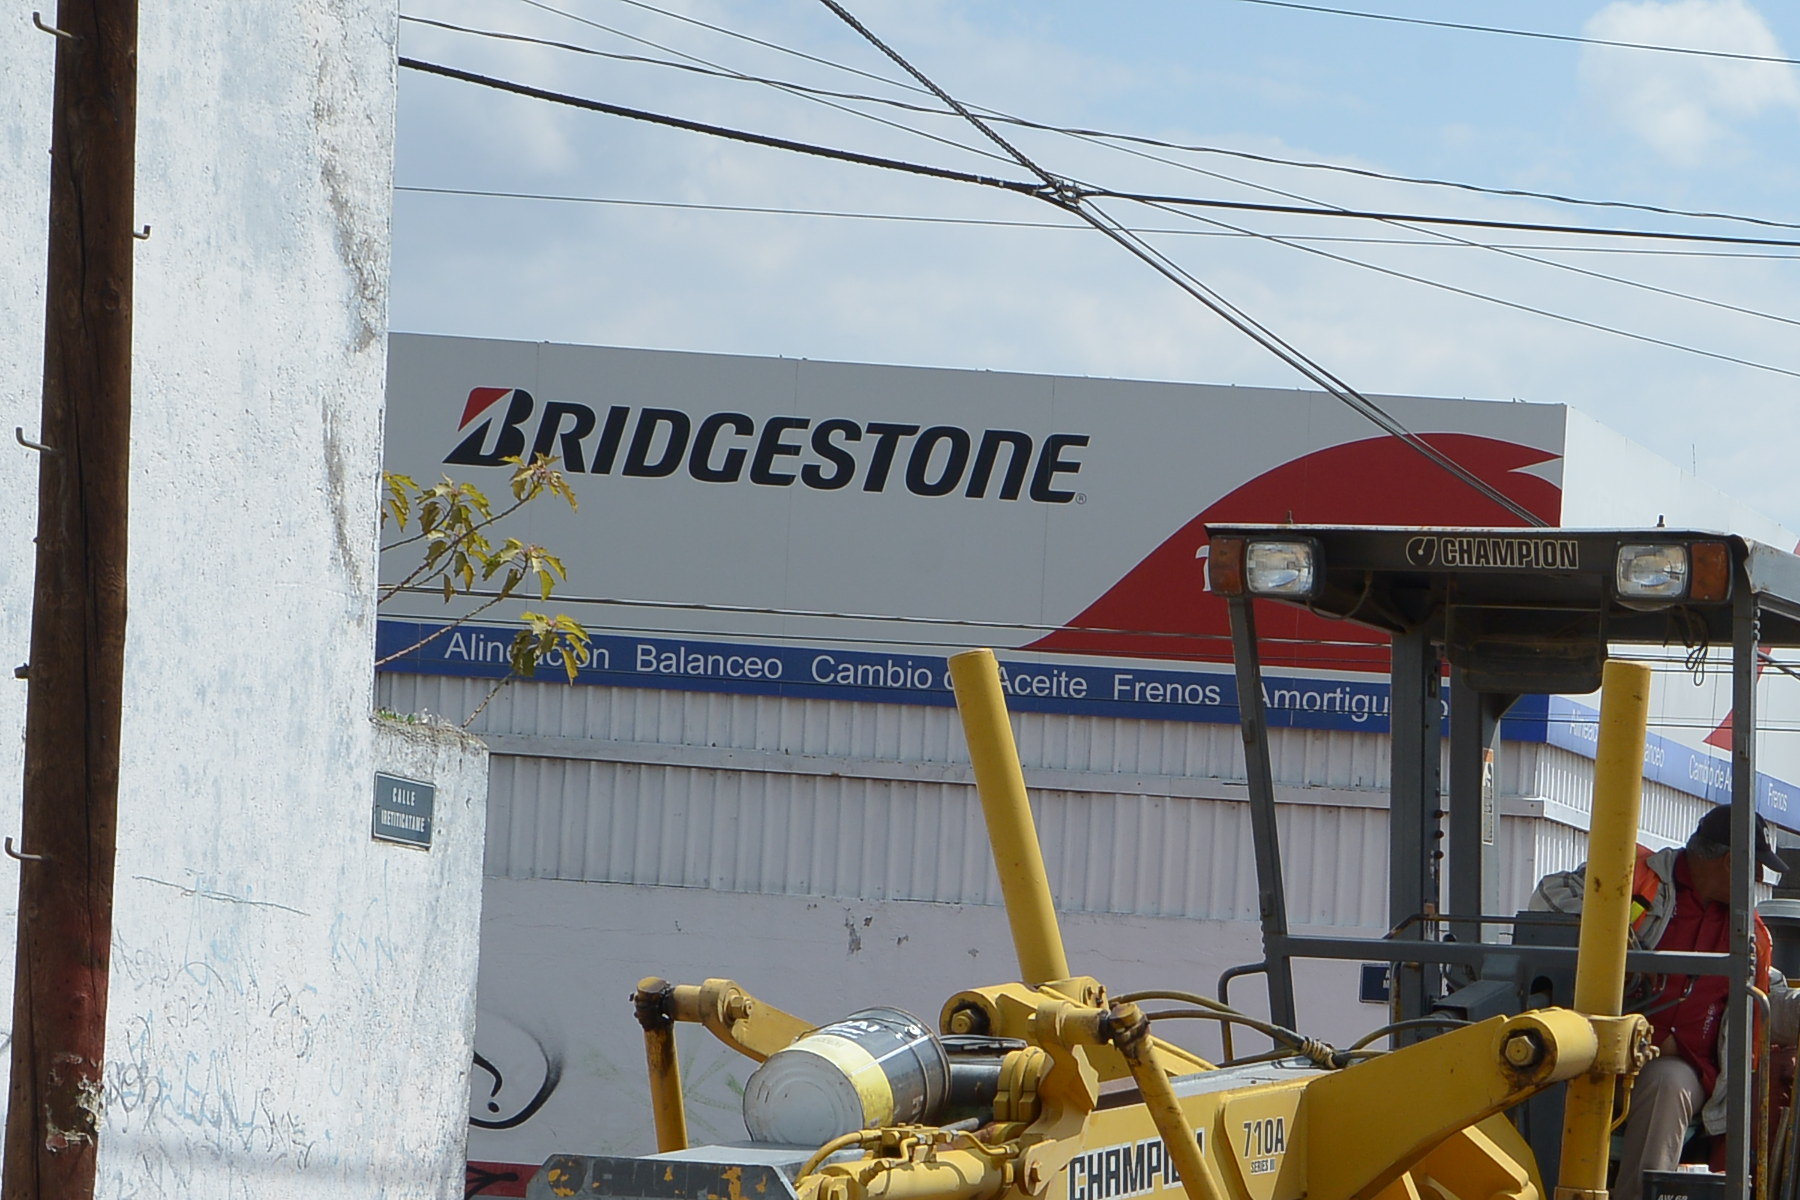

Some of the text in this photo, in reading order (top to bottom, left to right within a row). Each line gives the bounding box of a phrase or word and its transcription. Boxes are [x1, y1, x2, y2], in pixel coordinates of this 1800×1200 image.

[443, 386, 1090, 505] BRIDGESTONE
[1441, 537, 1579, 569] CHAMPION
[444, 632, 609, 669] Alincón
[636, 645, 783, 679] Balanceo
[811, 655, 932, 690] Cambio
[1113, 674, 1221, 706] Frenos
[1260, 681, 1450, 722] Amortigu
[392, 787, 416, 806] CALLE
[1243, 1116, 1285, 1158] 710A
